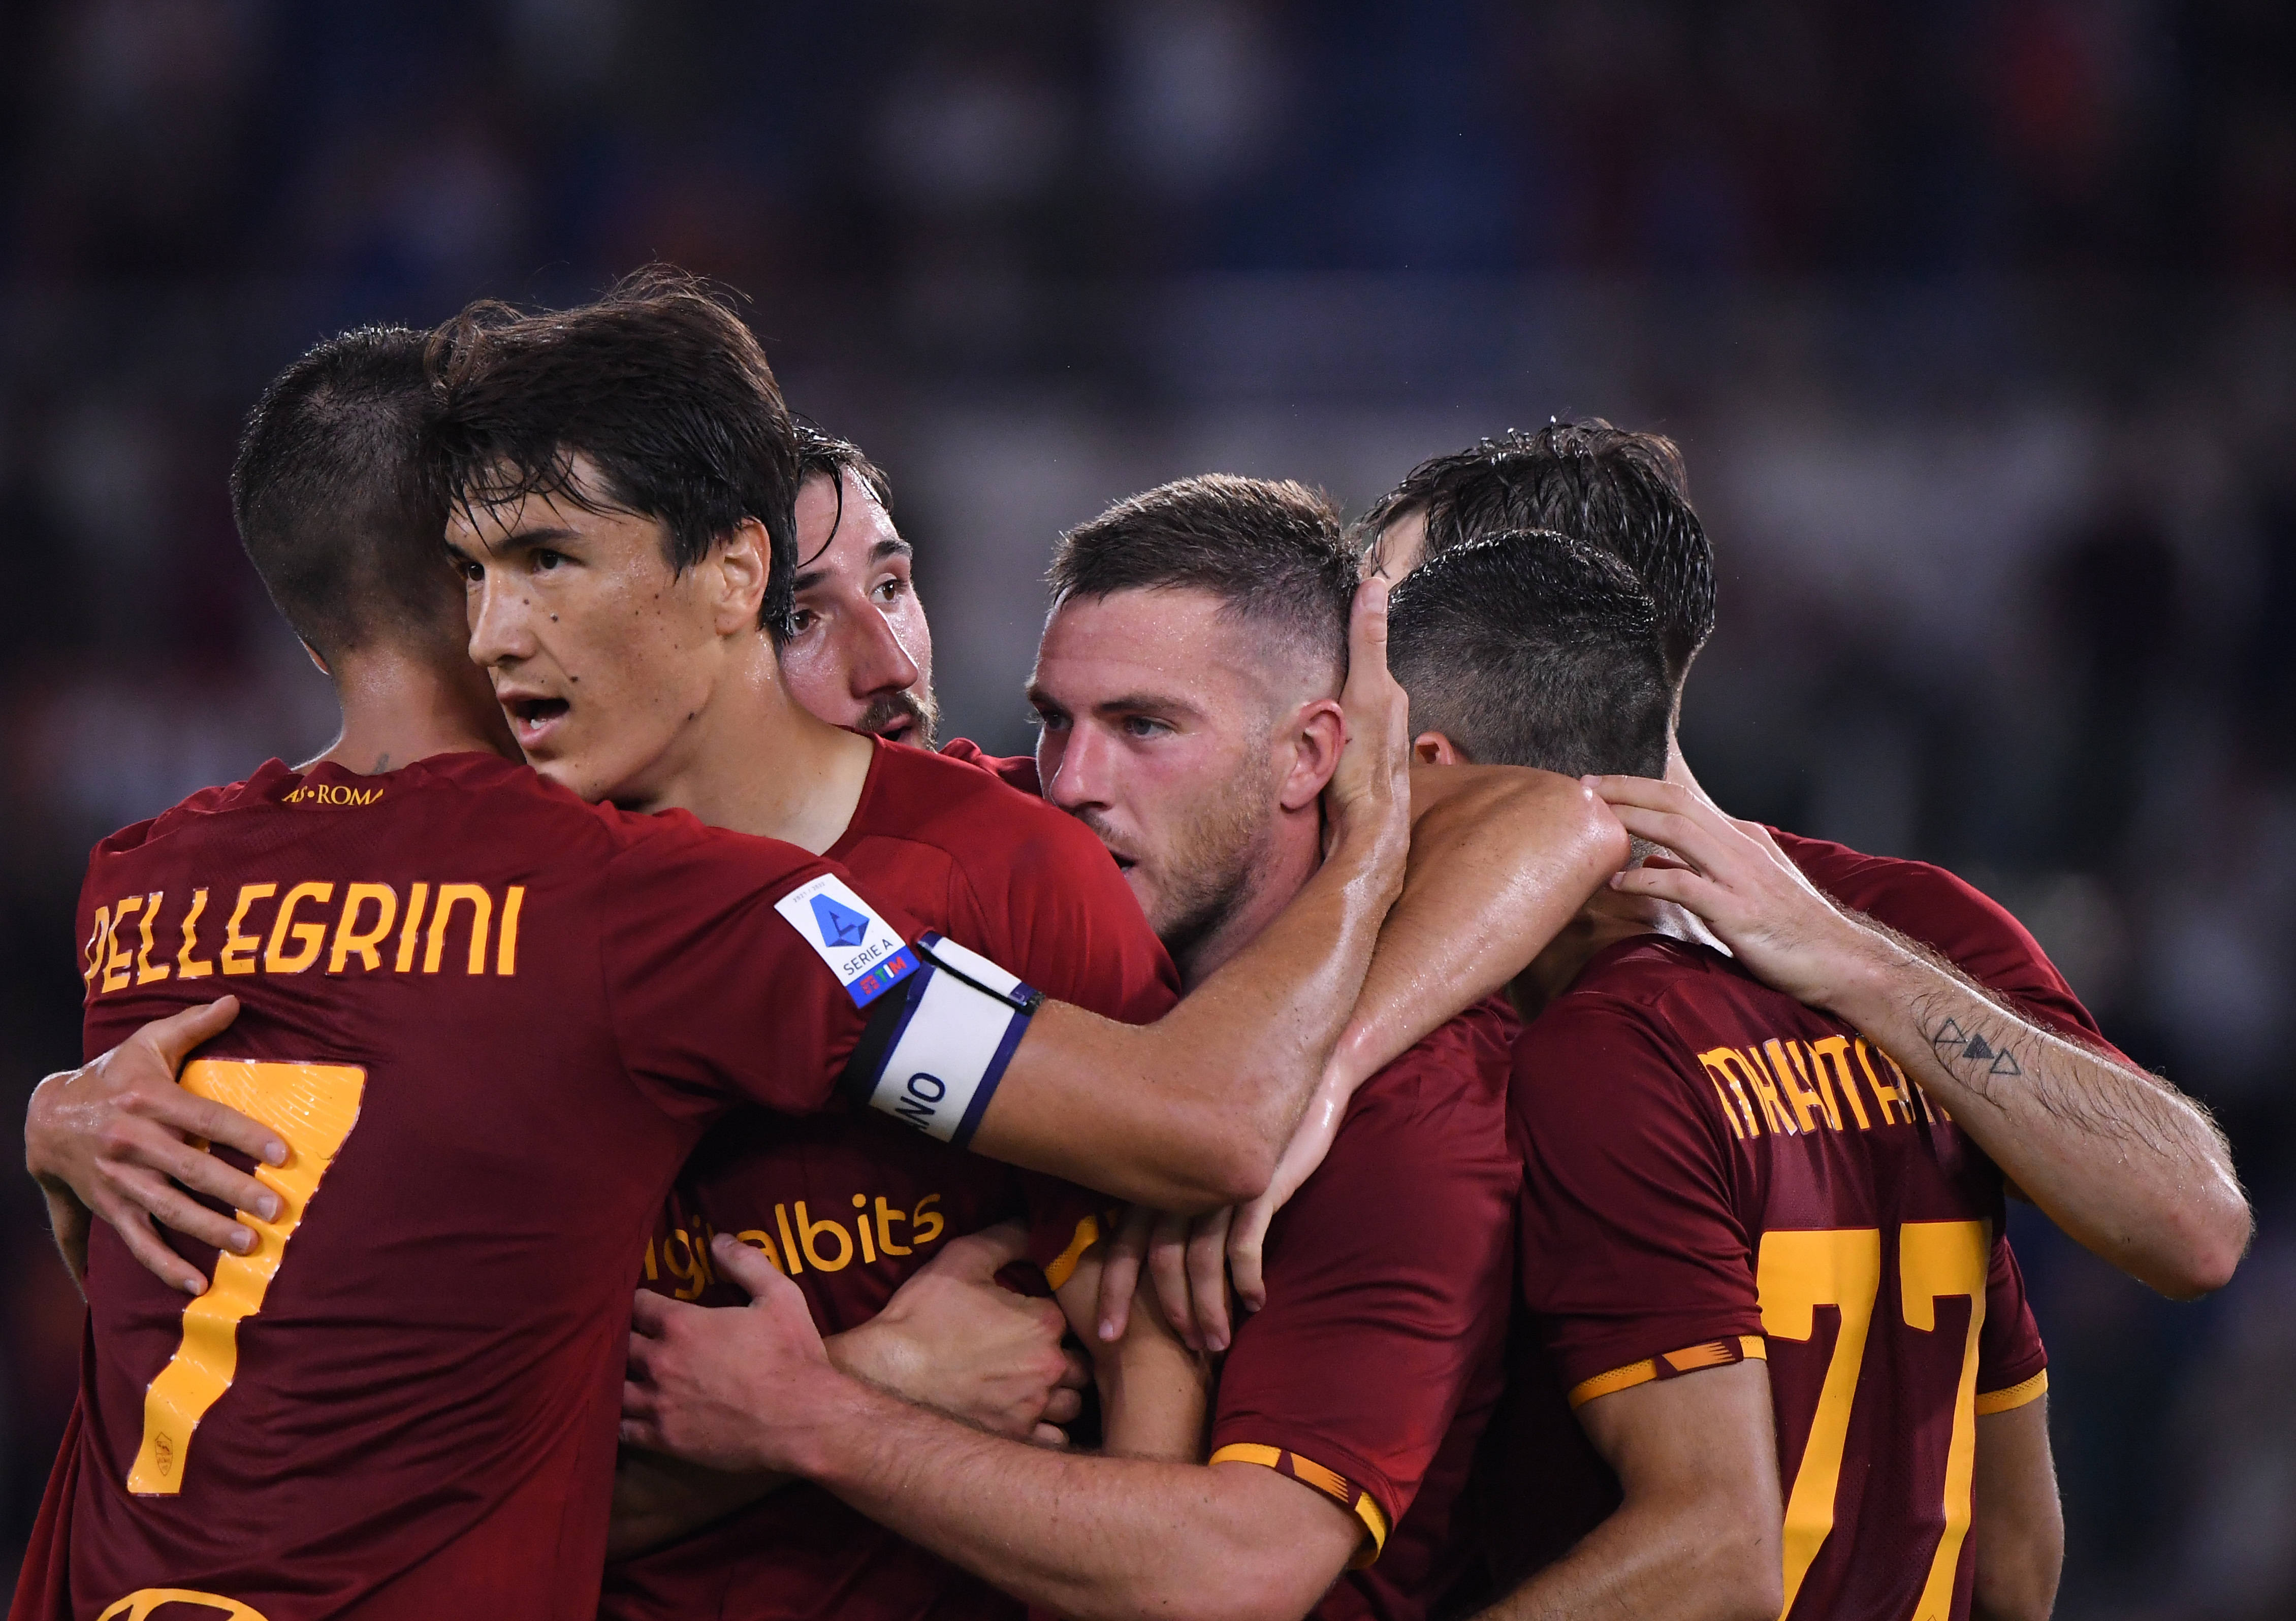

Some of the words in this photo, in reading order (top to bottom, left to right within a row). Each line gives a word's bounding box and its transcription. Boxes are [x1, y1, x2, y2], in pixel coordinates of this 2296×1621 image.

[84, 882, 525, 1001] PELLEGRINI
[843, 945, 882, 976] SERIE
[882, 938, 894, 951] A
[875, 956, 907, 983] TIM
[895, 1072, 946, 1129] NO
[127, 1059, 367, 1495] 7
[1756, 1220, 1993, 1621] 77
